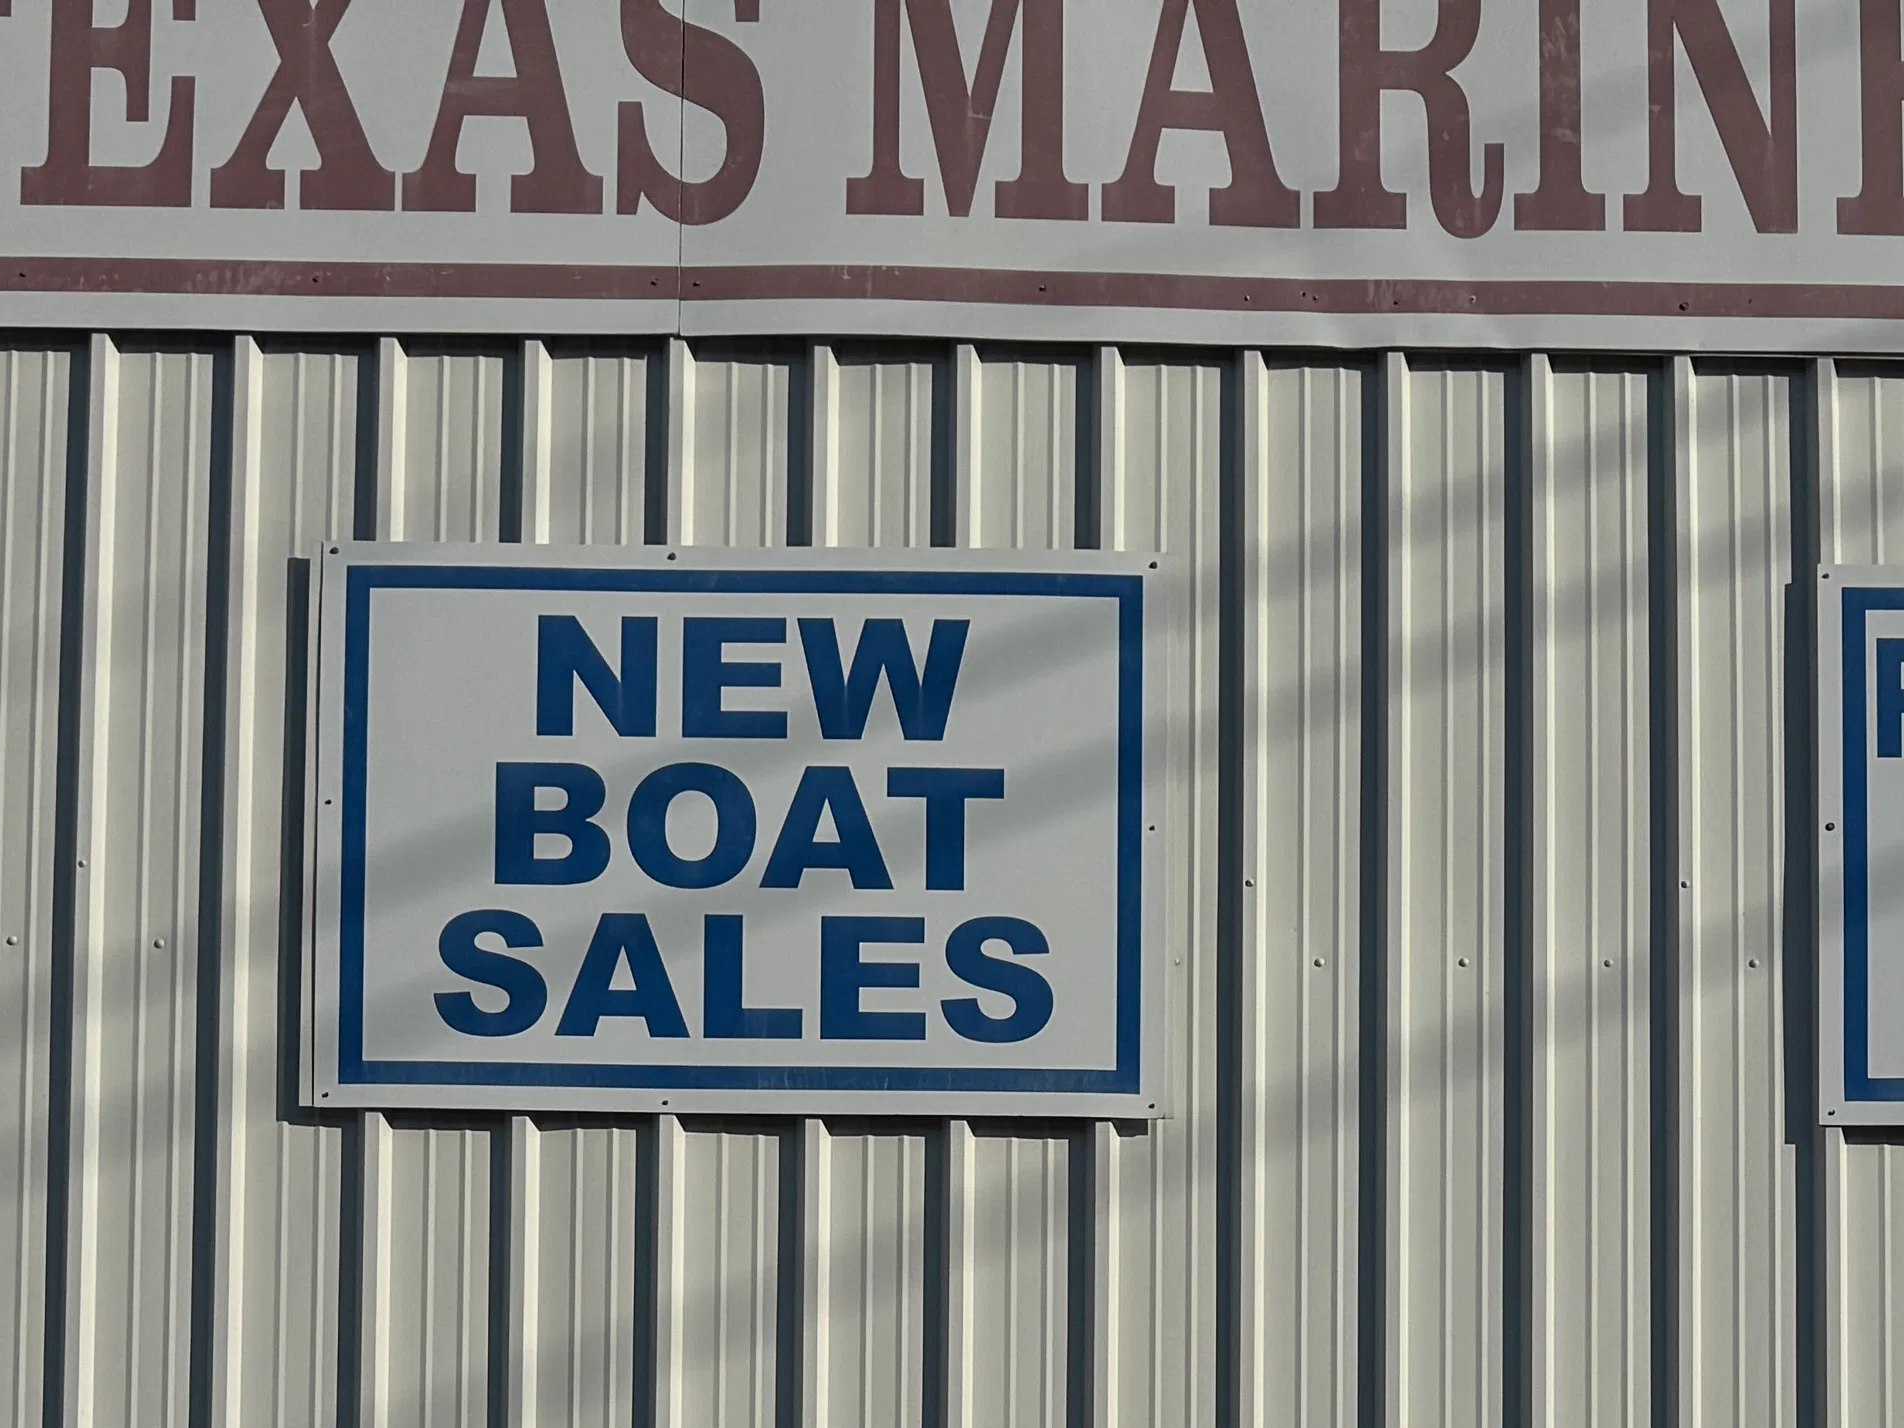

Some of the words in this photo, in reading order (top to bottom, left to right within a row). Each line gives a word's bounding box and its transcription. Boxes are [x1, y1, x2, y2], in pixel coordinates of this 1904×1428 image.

[535, 614, 971, 742] NEW
[493, 761, 1005, 892] BOAT
[432, 908, 1055, 1044] SALES
